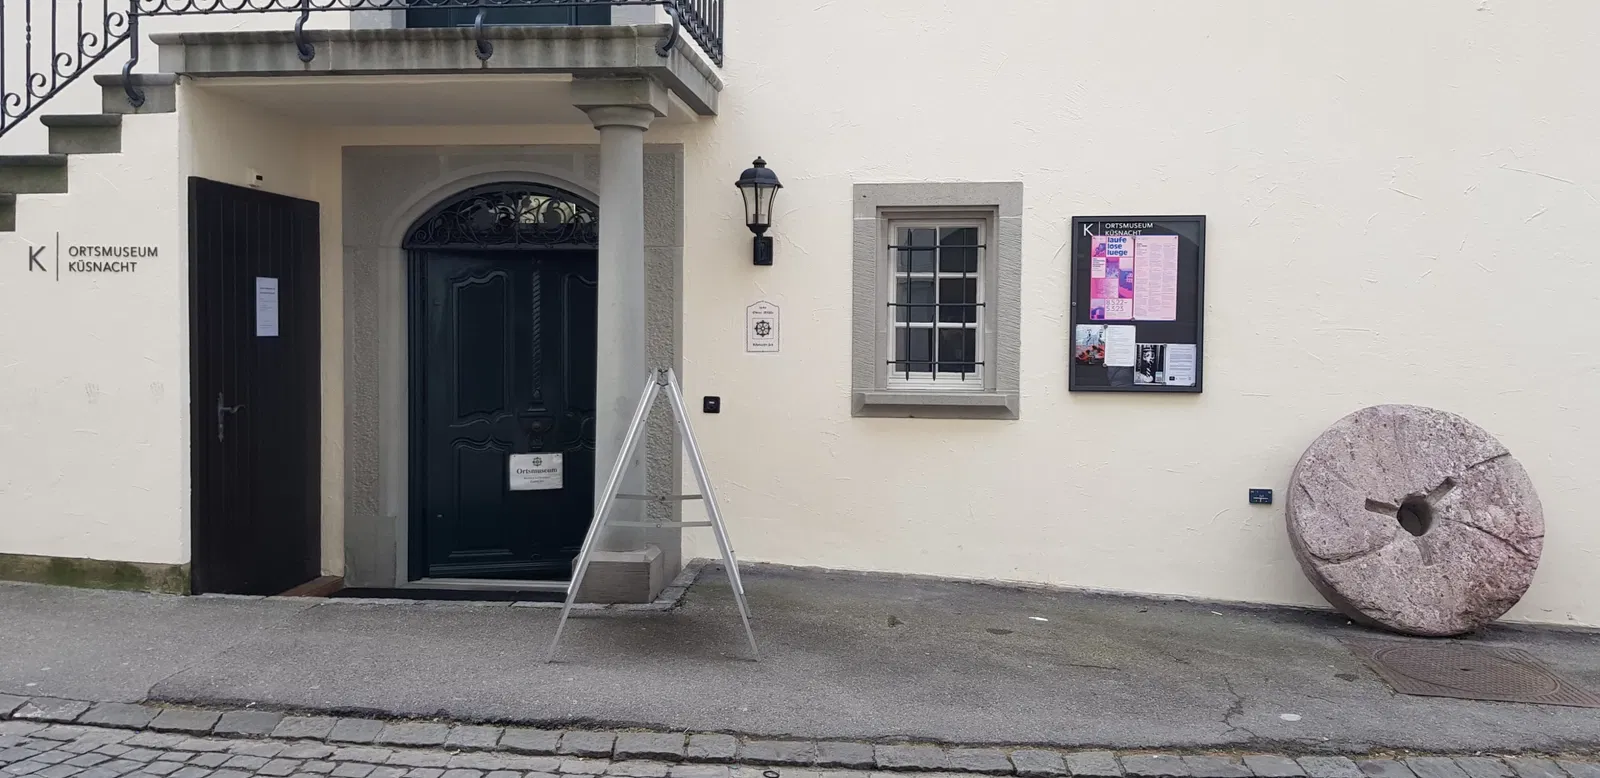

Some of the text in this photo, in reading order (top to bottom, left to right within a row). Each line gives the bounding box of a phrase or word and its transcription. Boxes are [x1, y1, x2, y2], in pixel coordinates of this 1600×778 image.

[1083, 223, 1095, 236] K
[68, 245, 158, 257] ORTSMUSEUM
[28, 245, 47, 272] K
[68, 260, 138, 272] KÜSNACHT
